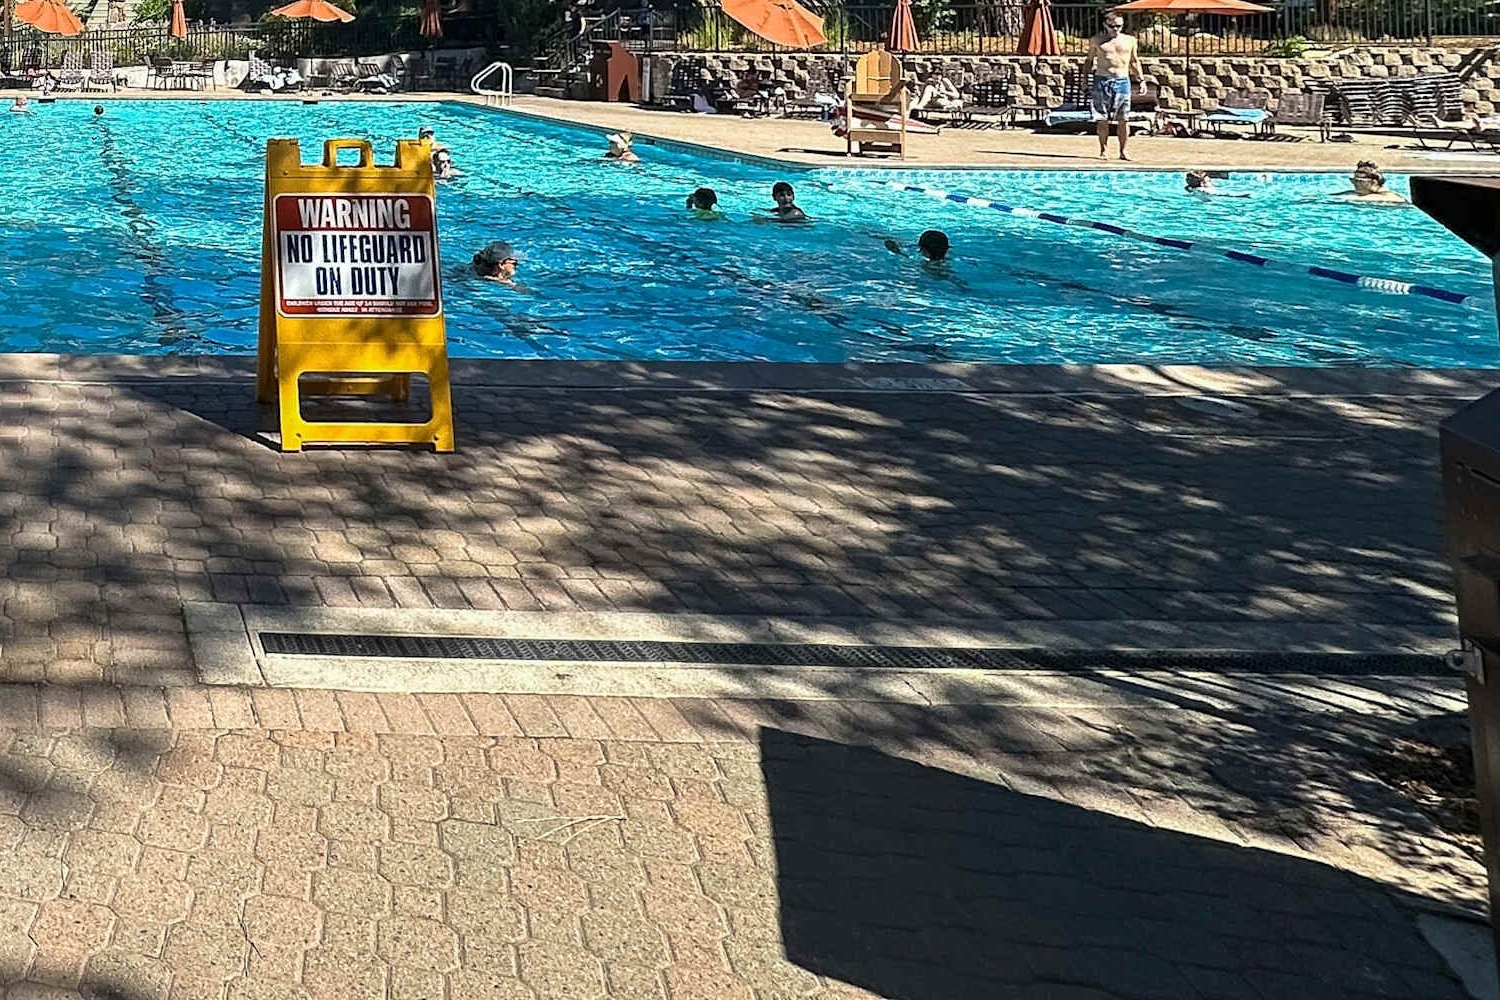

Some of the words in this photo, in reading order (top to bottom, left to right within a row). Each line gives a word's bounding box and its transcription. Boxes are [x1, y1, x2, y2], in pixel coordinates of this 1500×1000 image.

[298, 199, 411, 229] WARNING
[287, 234, 313, 263] NO
[323, 234, 426, 263] LIFEGUARD
[316, 267, 342, 295] ON
[351, 267, 400, 295] DUTY
